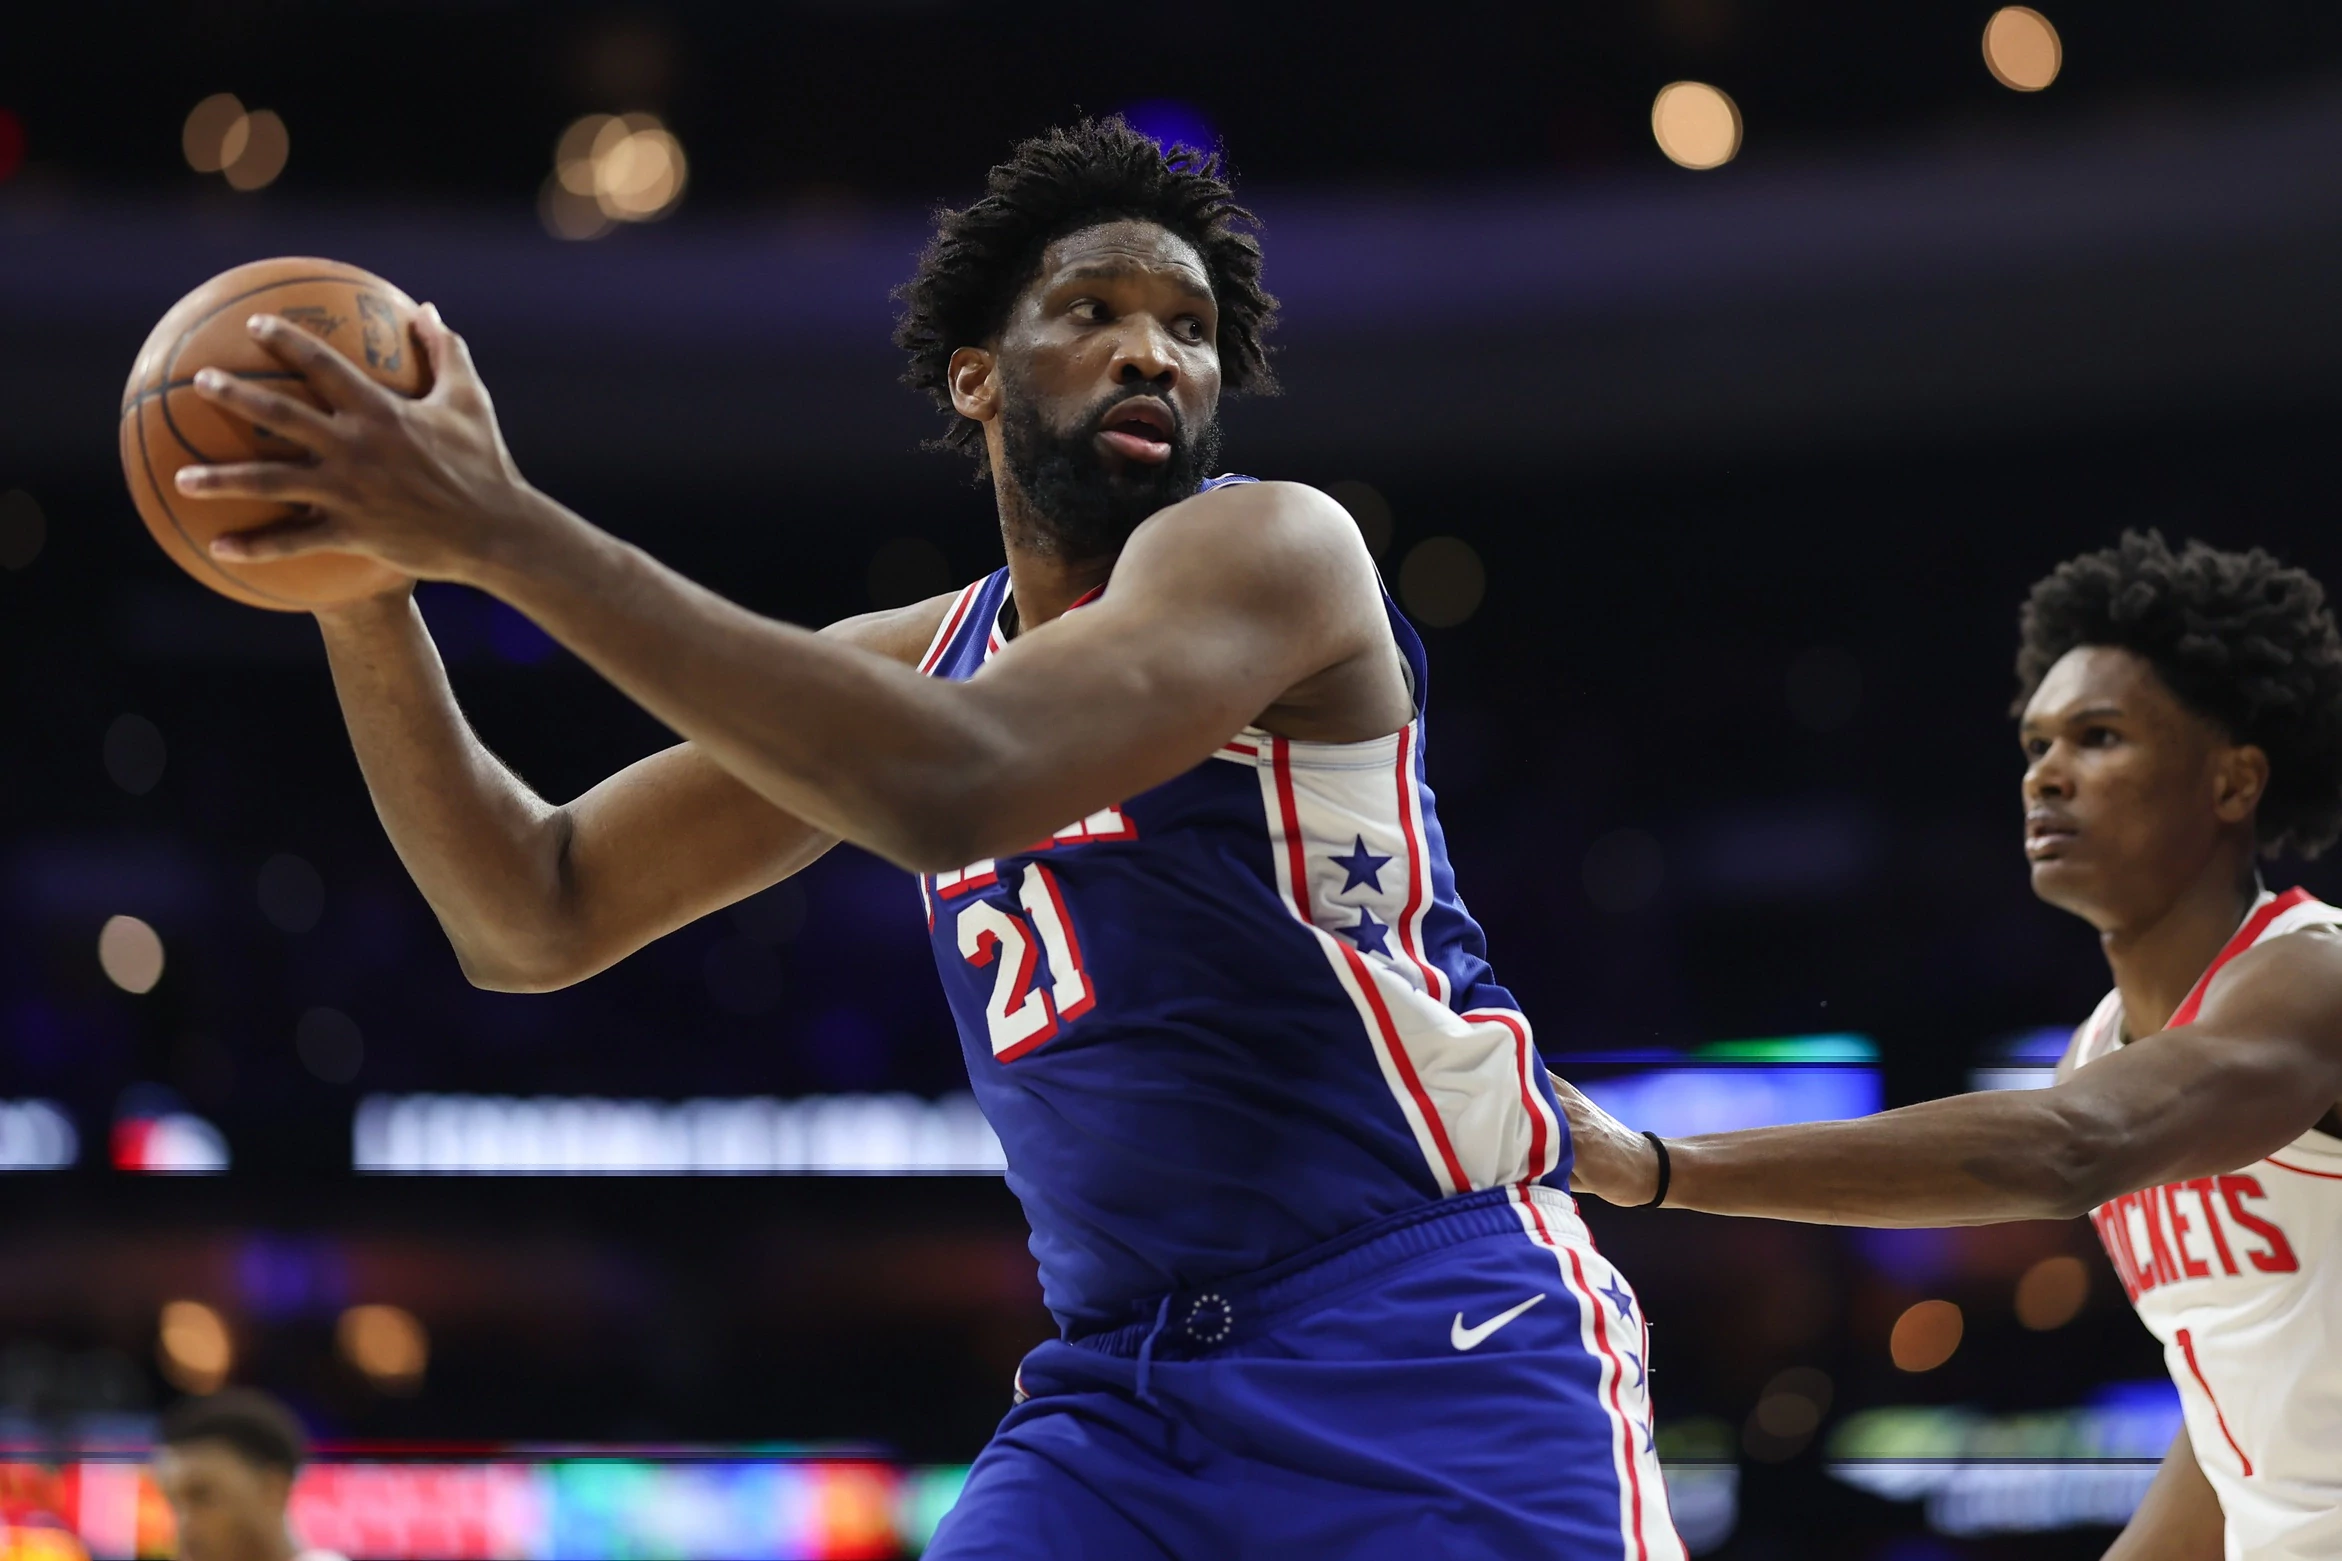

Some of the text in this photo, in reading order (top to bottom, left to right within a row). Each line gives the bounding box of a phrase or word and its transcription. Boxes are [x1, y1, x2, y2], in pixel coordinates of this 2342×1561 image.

[957, 862, 1096, 1064] 21
[2091, 1174, 2300, 1306] OCKETS
[2175, 1328, 2253, 1477] 1
